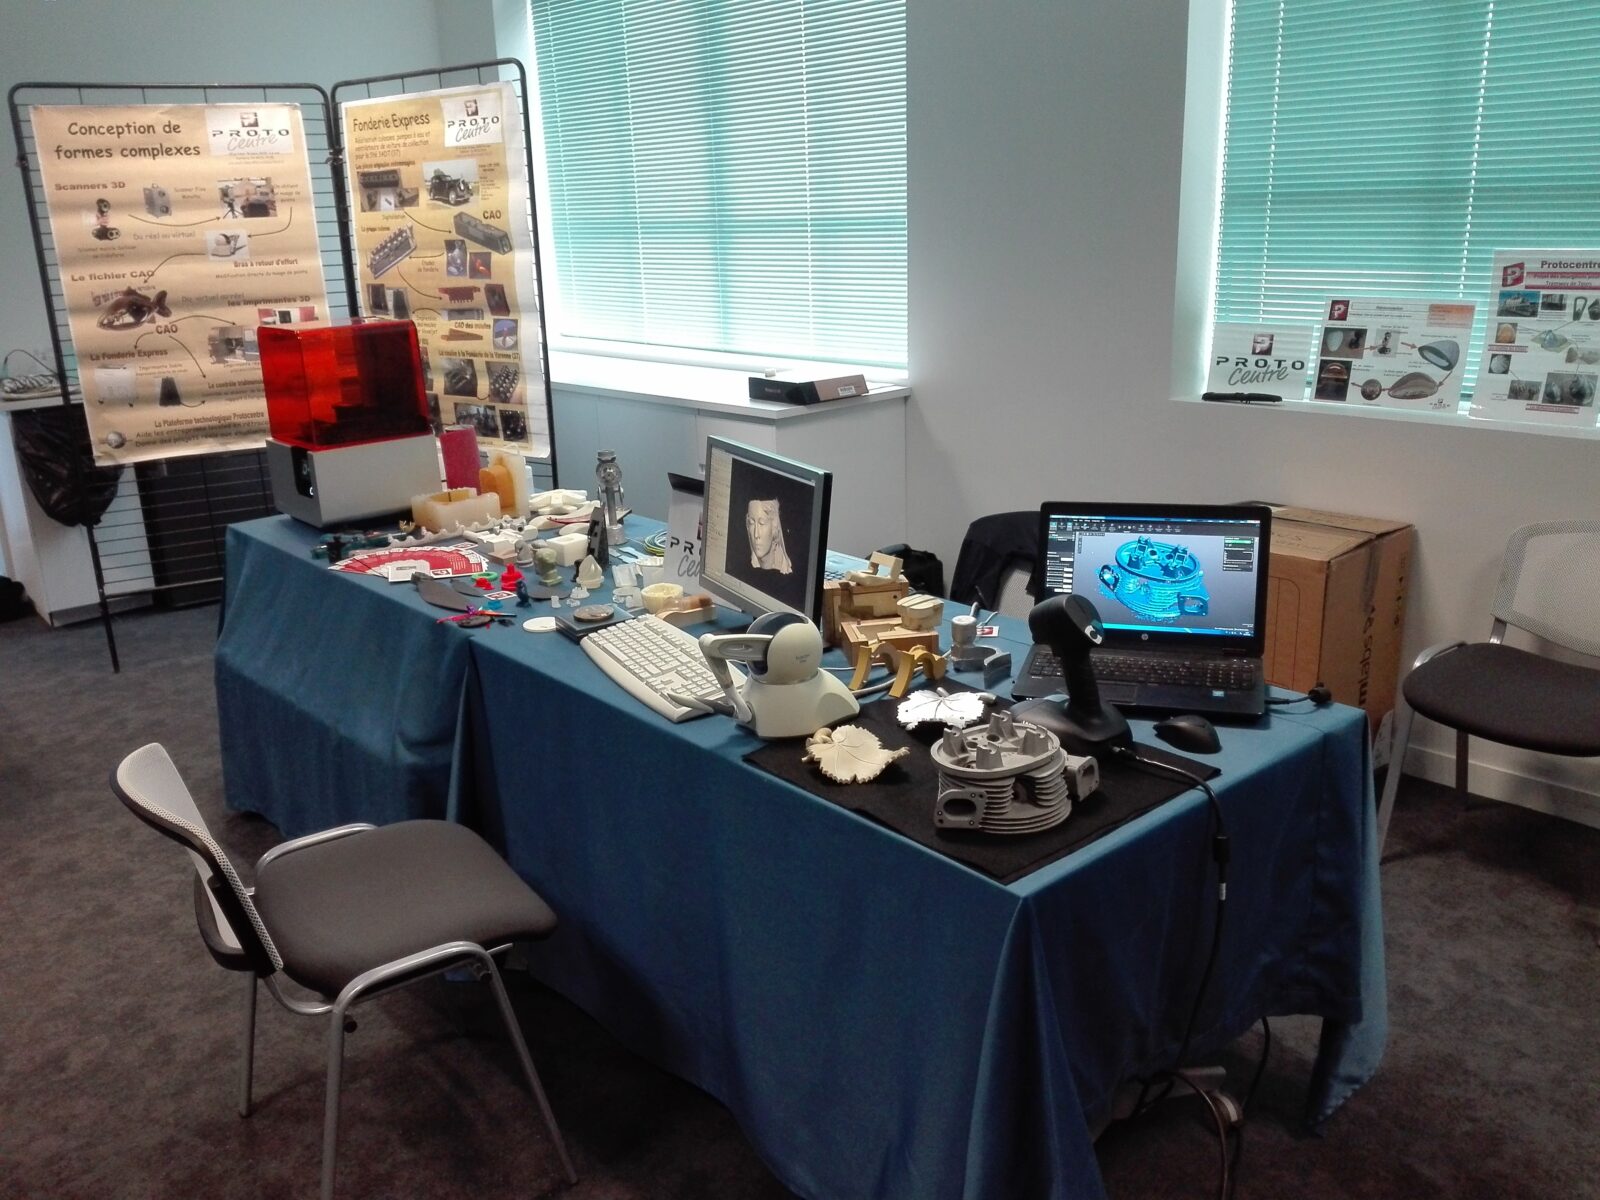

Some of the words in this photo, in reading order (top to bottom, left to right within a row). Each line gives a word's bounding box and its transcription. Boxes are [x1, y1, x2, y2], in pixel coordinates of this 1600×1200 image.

[353, 116, 391, 132] Fonderie
[391, 113, 430, 130] Express
[448, 116, 500, 128] PROTO
[68, 121, 156, 139] Conception
[162, 120, 182, 134] de
[212, 129, 289, 138] PROTO
[456, 122, 490, 142] Centre
[227, 134, 278, 151] Centre
[54, 145, 113, 160] formes
[120, 143, 201, 160] complexes
[54, 182, 108, 191] Scanners
[111, 181, 126, 190] 3D
[482, 210, 501, 220] CAO
[88, 272, 127, 280] fichier
[130, 270, 154, 278] CAO
[156, 324, 178, 334] CAO
[102, 350, 135, 360] Fonderie
[138, 349, 168, 358] Express
[1216, 356, 1304, 370] PROTO
[1228, 365, 1289, 386] Centre
[670, 536, 701, 555] PR
